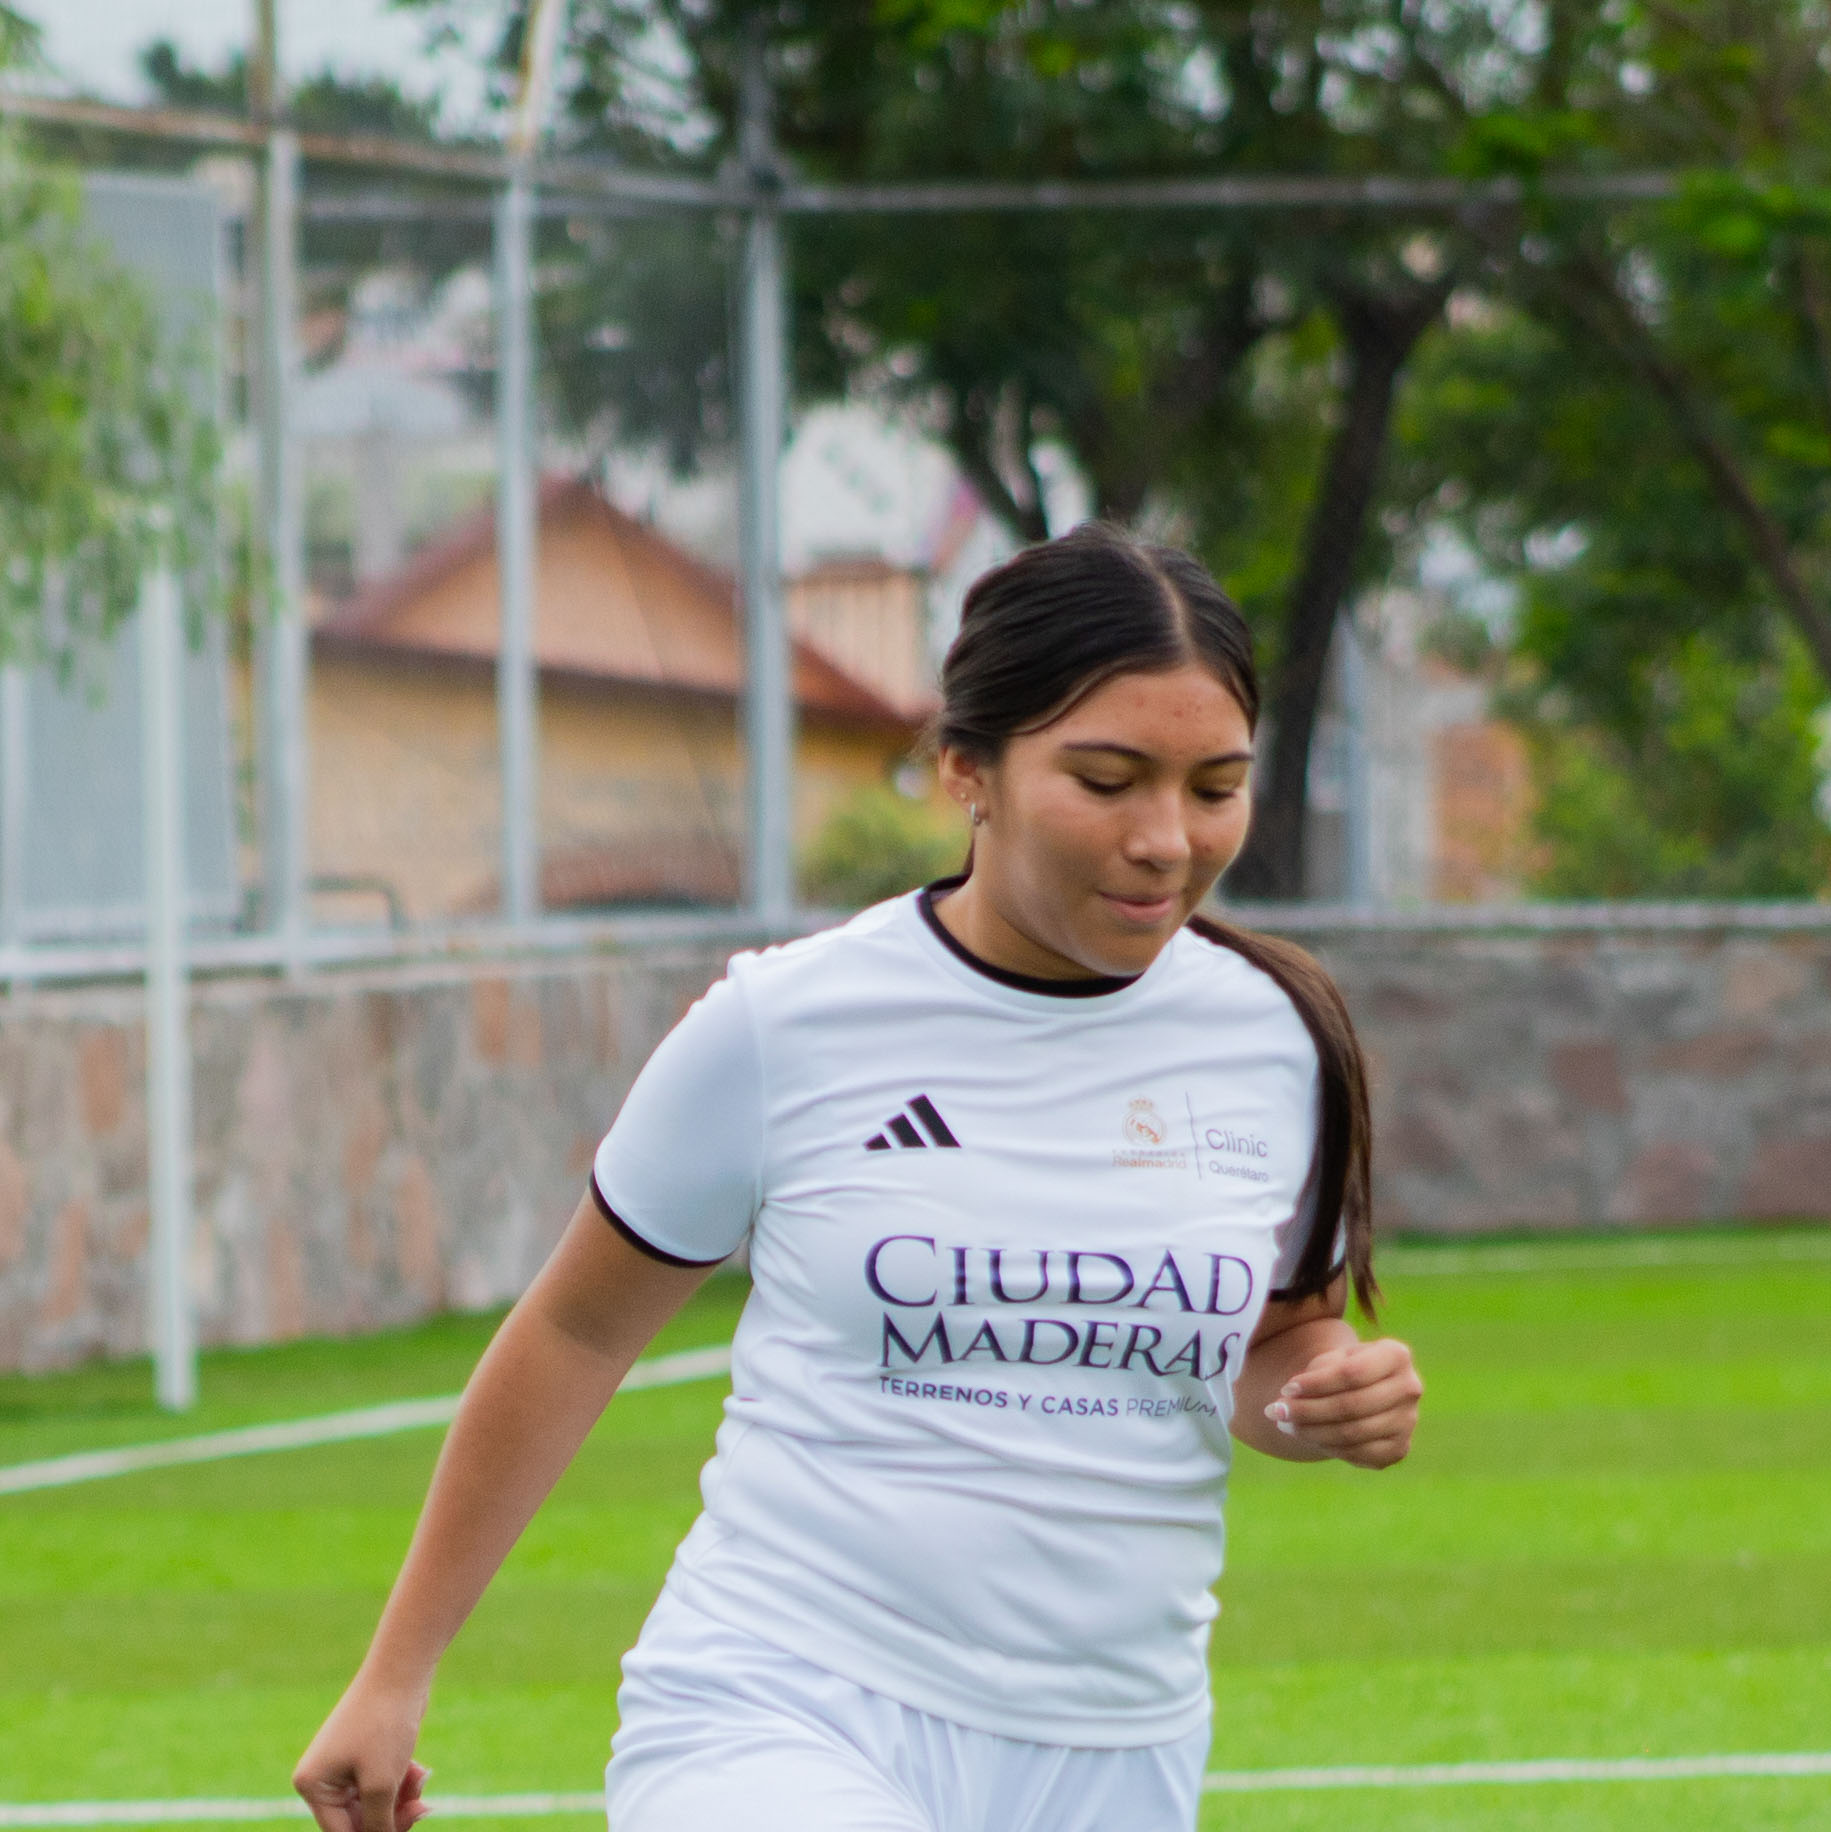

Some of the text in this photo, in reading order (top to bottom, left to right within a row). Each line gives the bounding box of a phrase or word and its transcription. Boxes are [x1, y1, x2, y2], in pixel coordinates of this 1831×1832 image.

[1205, 1128, 1268, 1158] Clinic
[878, 1311, 1241, 1381] MADERAS
[880, 1375, 1007, 1408] TERRENOS
[1018, 1394, 1033, 1411] Y
[1041, 1396, 1120, 1416] CASAS
